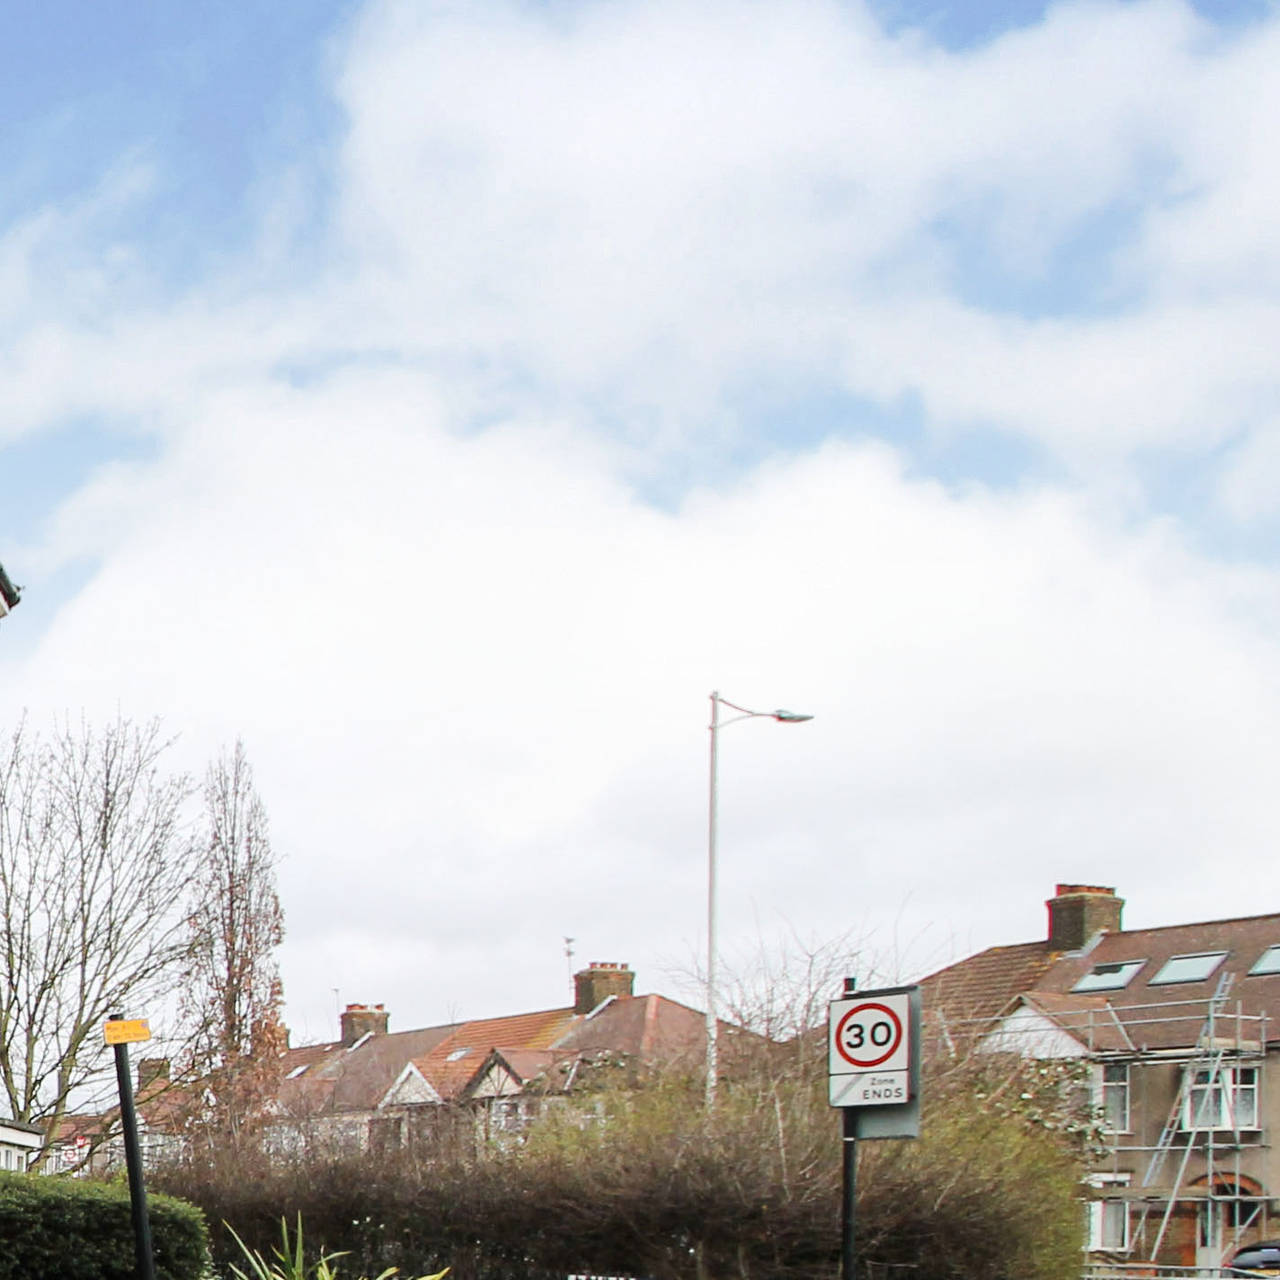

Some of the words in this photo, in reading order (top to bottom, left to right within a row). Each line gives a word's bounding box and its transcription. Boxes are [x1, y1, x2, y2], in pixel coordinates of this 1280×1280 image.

[845, 1021, 892, 1049] 30
[871, 1077, 896, 1086] Zone
[863, 1088, 903, 1100] ENDS
